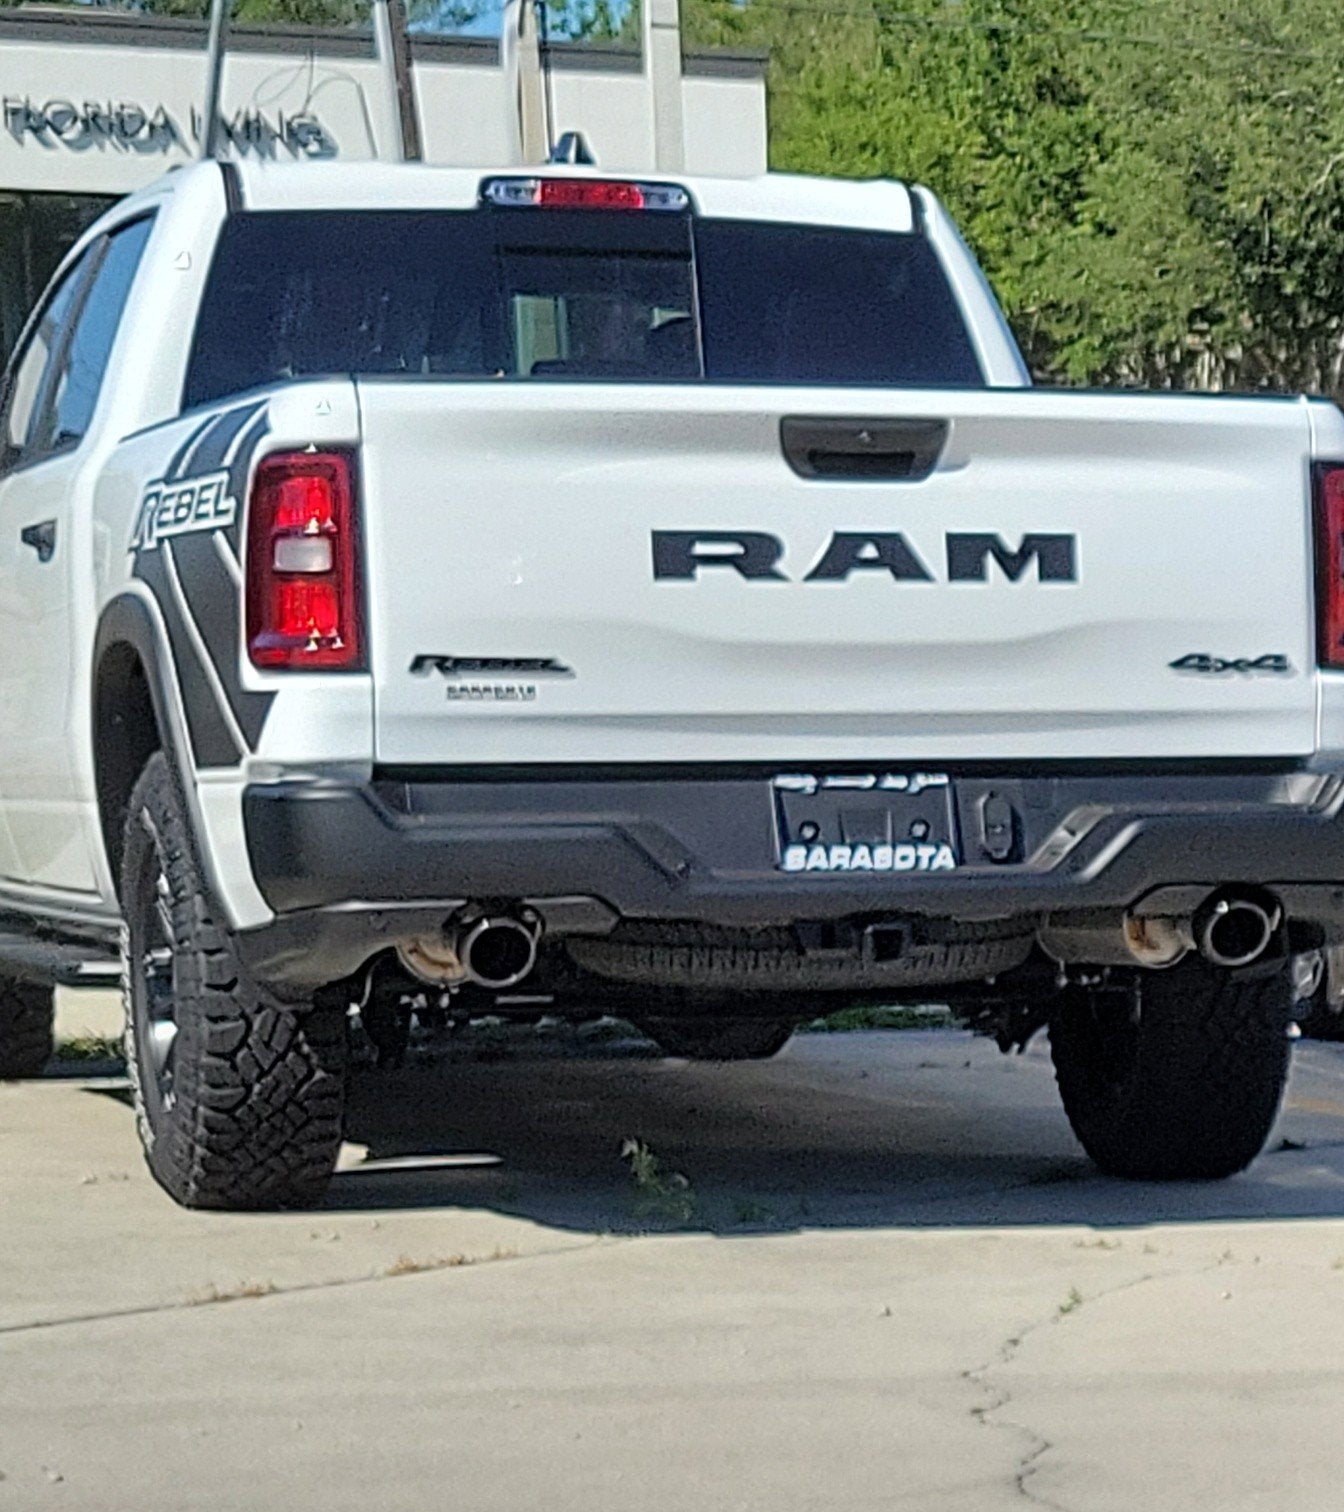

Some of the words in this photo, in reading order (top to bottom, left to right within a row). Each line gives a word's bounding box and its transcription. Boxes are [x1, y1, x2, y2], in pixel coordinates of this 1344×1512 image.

[3, 96, 178, 144] FLORIDA
[190, 102, 326, 152] LVING
[130, 471, 236, 550] REBEL
[651, 529, 1079, 582] RAM
[781, 845, 956, 872] SARASOTA
